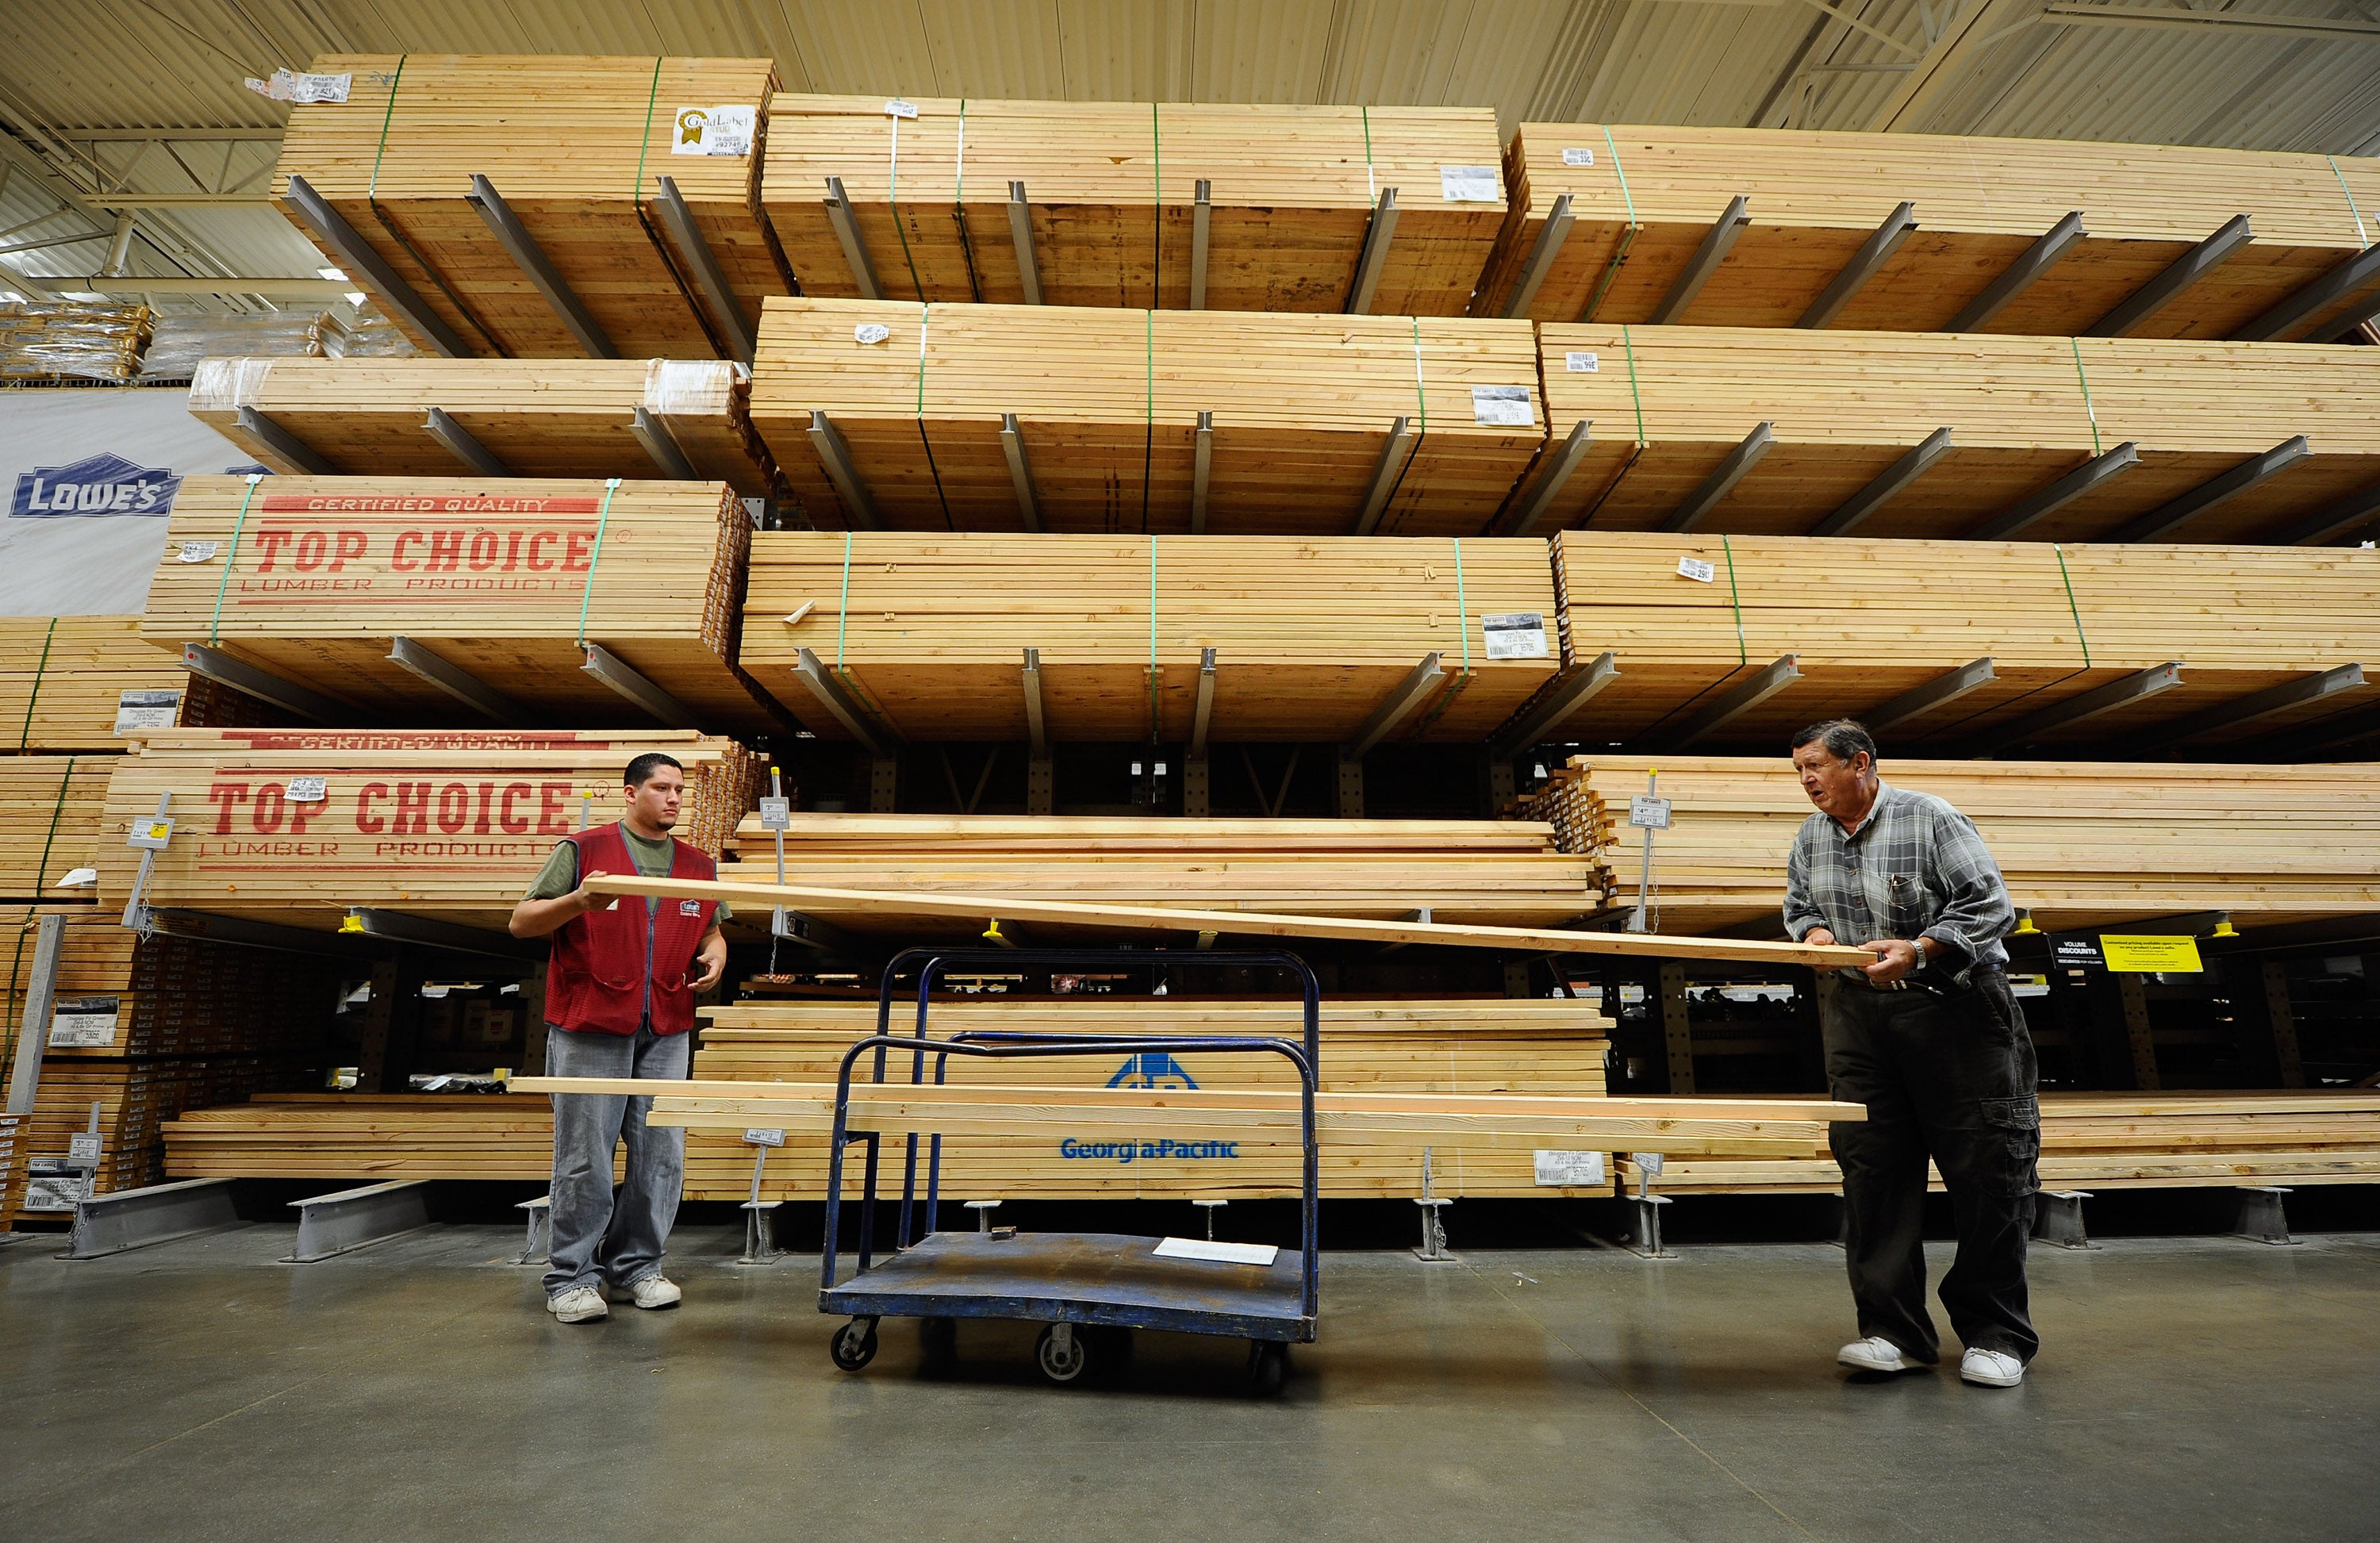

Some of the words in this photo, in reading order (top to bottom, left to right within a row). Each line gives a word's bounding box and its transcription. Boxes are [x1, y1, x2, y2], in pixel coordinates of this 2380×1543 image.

[687, 115, 716, 127] Gold
[717, 114, 748, 127] Label
[28, 478, 162, 511] LOWE'S
[308, 499, 435, 510] CERTIFIED
[444, 499, 550, 512] QUALITY
[255, 530, 368, 573] TOP
[392, 530, 597, 572] CHOICE
[240, 578, 373, 592] LUMBER
[405, 578, 587, 590] PRODUCTS
[209, 782, 328, 835] TOP
[356, 782, 572, 835] CHOICE
[198, 843, 339, 857] LUMBER
[1061, 1137, 1239, 1163] Georgia-Pacific
